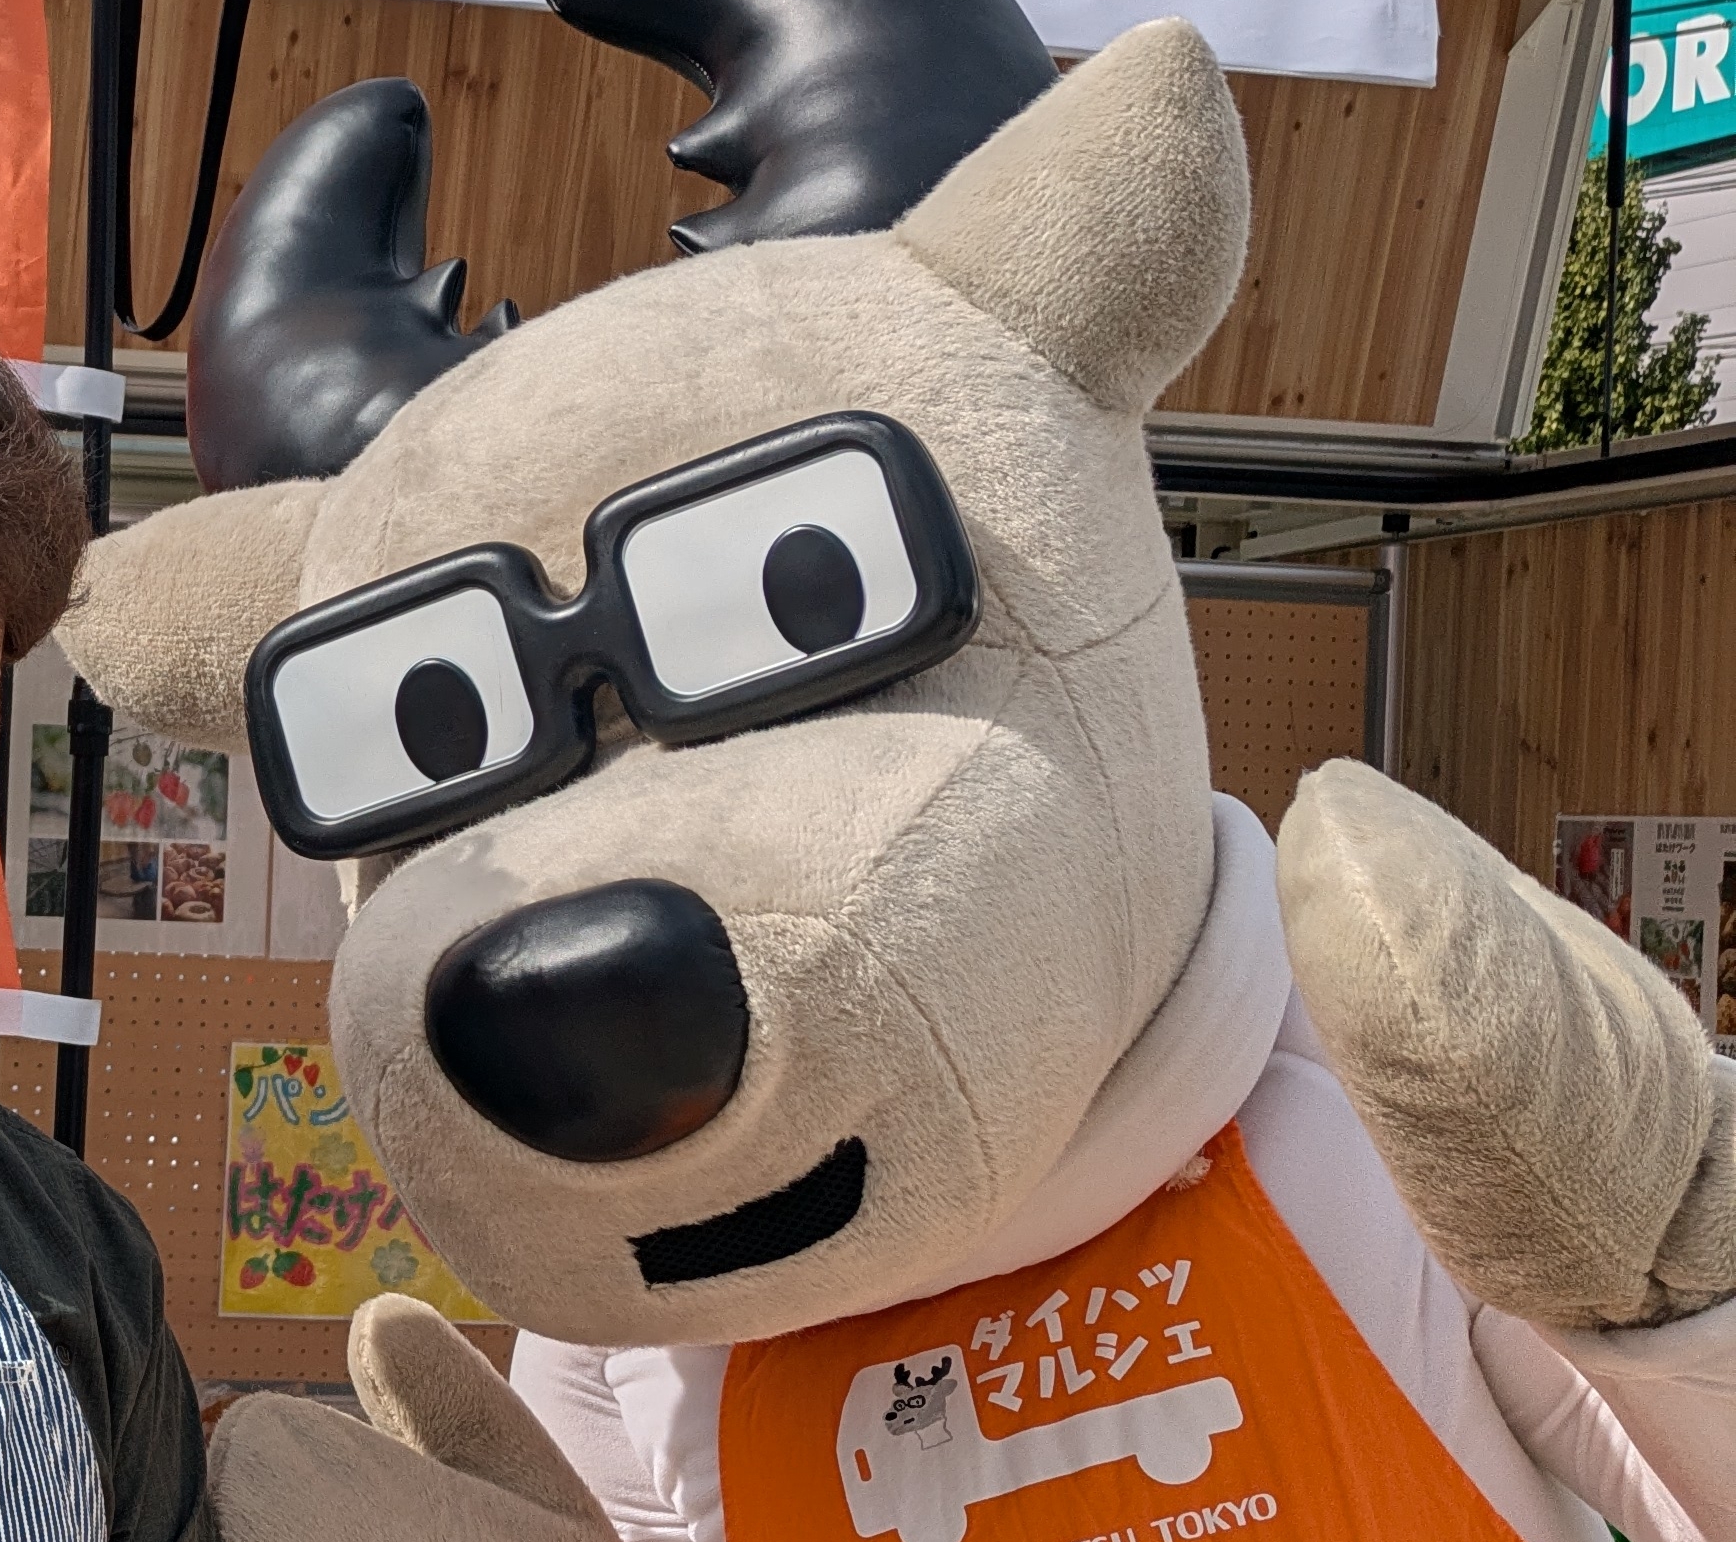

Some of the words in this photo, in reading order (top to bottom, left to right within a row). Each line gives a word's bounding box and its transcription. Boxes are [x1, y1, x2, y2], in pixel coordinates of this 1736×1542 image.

[1600, 12, 1736, 126] OR
[970, 1259, 1192, 1360] ダイハツ
[976, 1320, 1212, 1413] マルシェ
